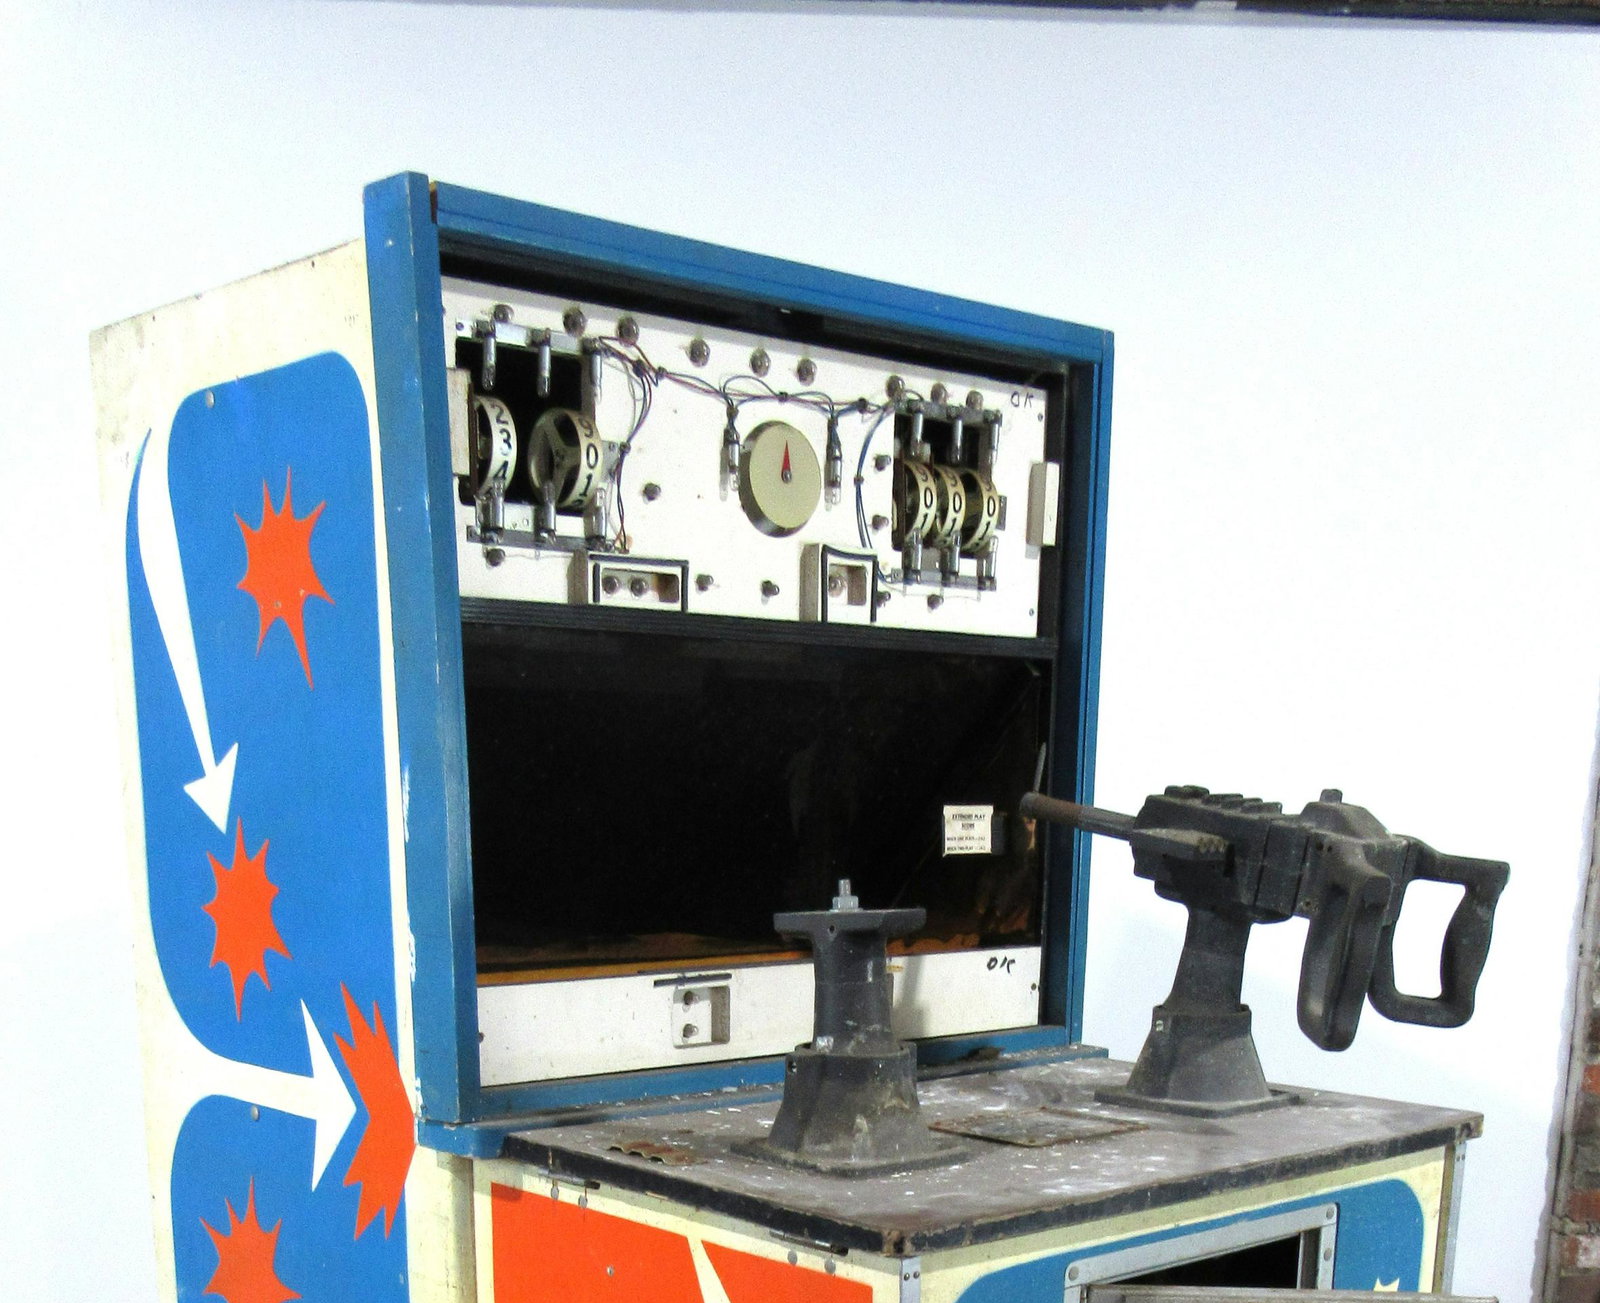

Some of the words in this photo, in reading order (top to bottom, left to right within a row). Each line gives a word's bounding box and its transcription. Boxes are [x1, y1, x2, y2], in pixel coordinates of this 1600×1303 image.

[499, 428, 512, 456] 3
[586, 443, 598, 469] 0
[579, 473, 592, 497] 1
[924, 487, 933, 509] 0
[953, 491, 962, 513] 0
[987, 496, 996, 517] 0
